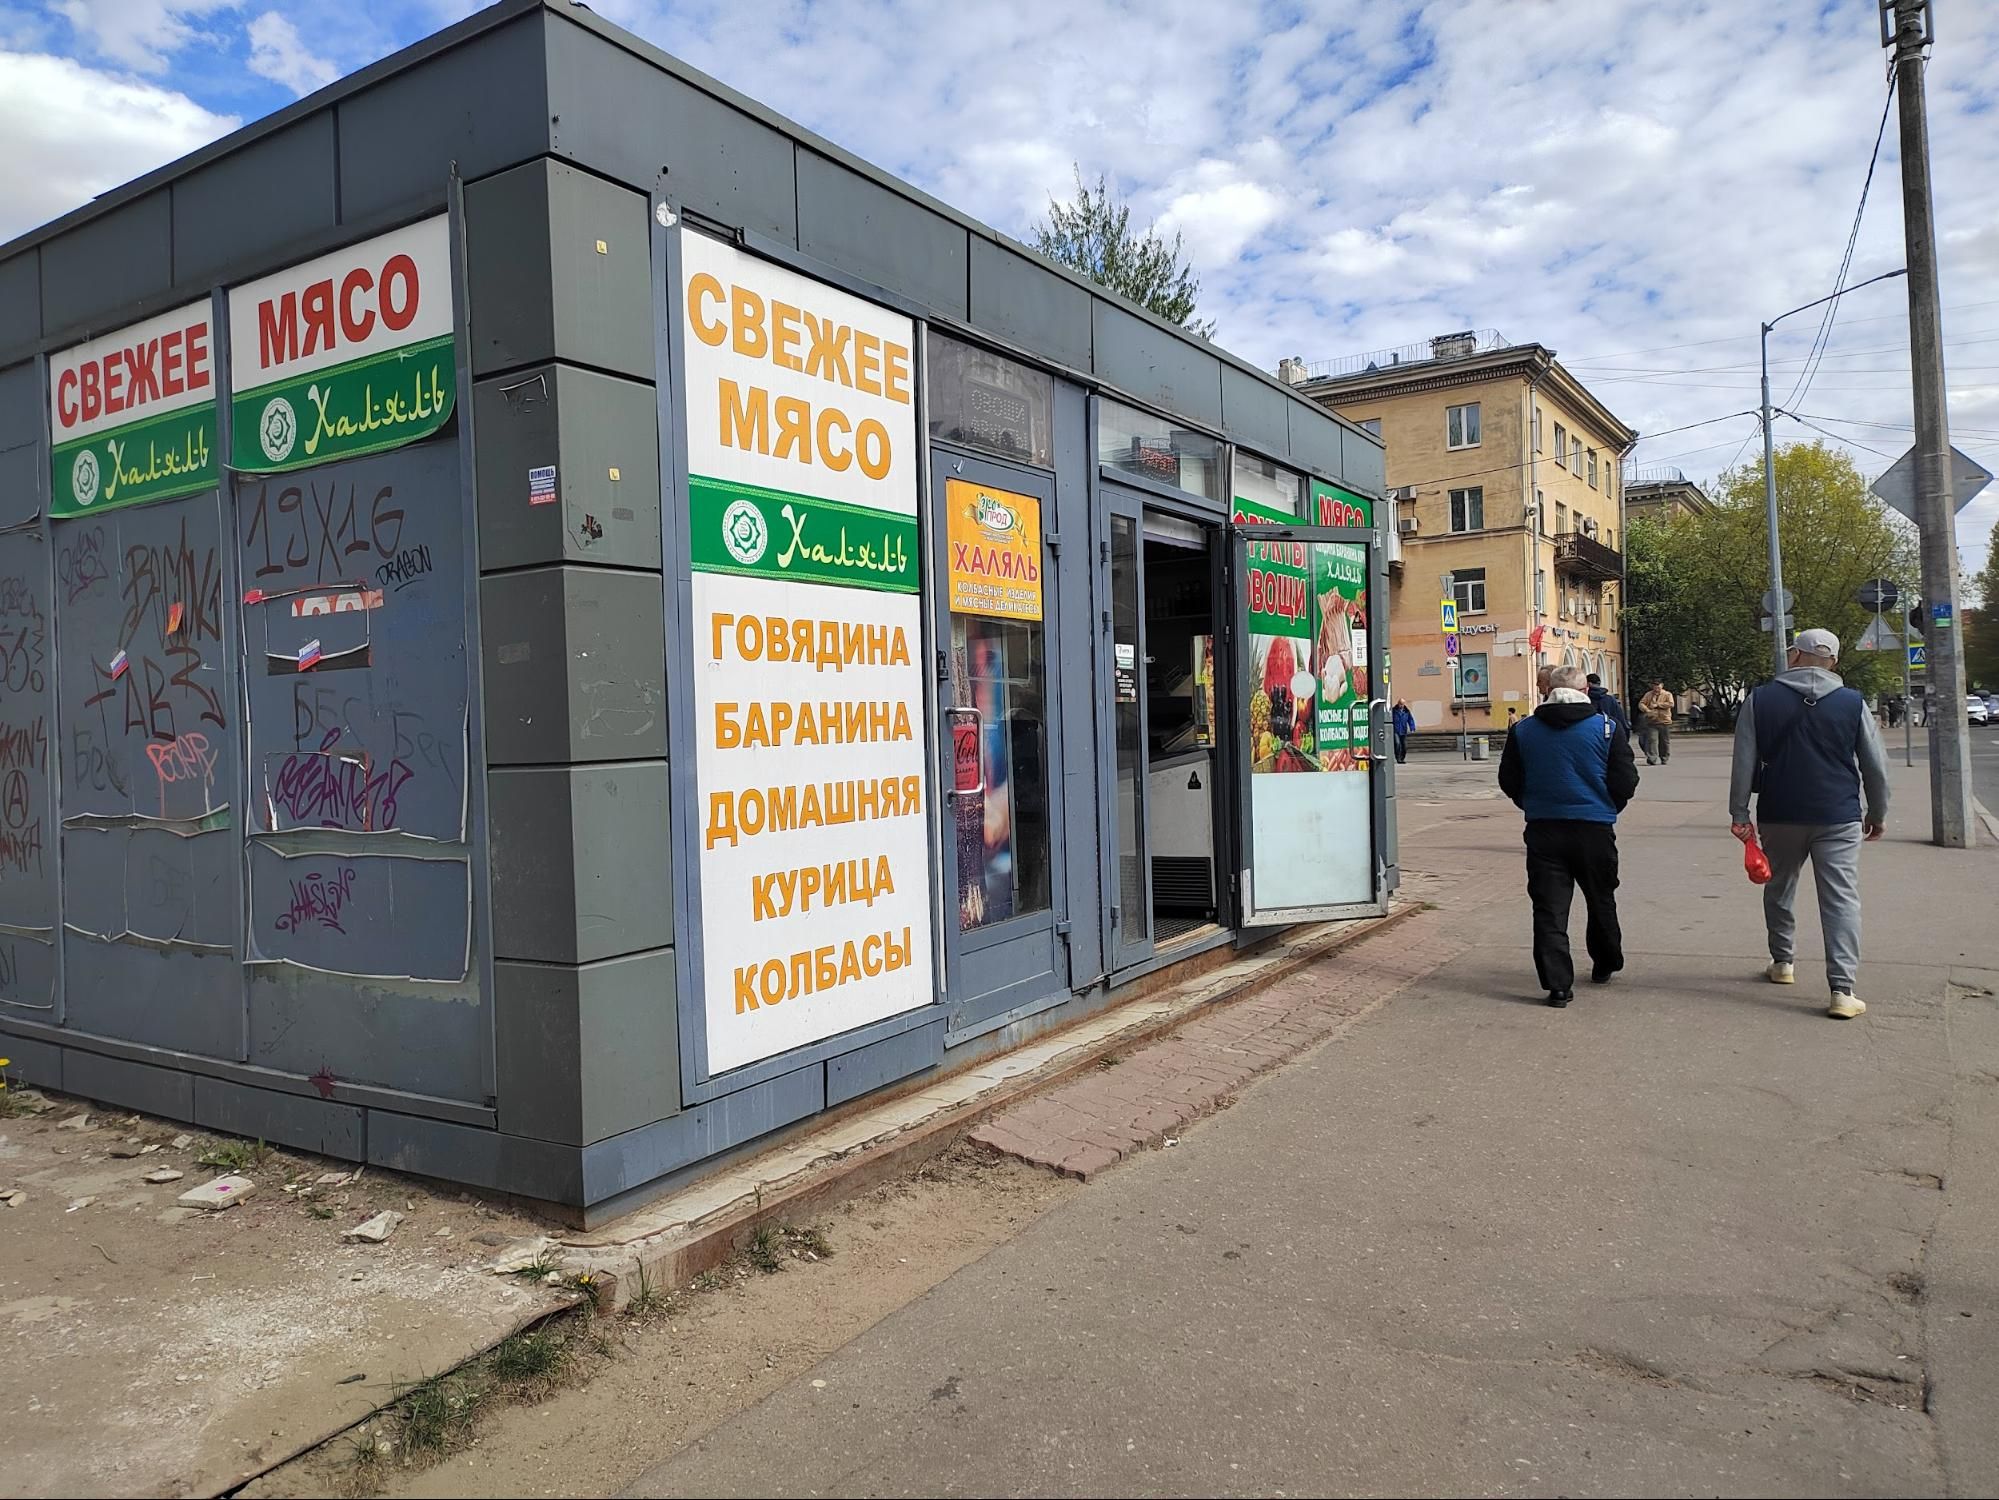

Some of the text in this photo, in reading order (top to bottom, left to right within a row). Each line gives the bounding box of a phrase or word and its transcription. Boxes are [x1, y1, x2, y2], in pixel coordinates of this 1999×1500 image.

[58, 254, 419, 428] СВЕЖЕЕ МЯСО
[688, 272, 910, 405] СВЕЖЕЕ
[718, 377, 892, 480] МЯСО
[954, 541, 1038, 582] ХАЛЯЛЬ
[957, 581, 1003, 597] КОЛБАСНЫЕ
[962, 597, 994, 610] МЯСНЫЕ
[1247, 568, 1308, 626] ВОЩИ
[711, 612, 911, 673] ГОВЯДИНА
[714, 702, 913, 749] БАРАНИНА
[706, 775, 921, 851] ДОМАШНЯЯ
[752, 855, 895, 922] КУРИЦА
[734, 927, 912, 1015] КОЛБАСЫ
